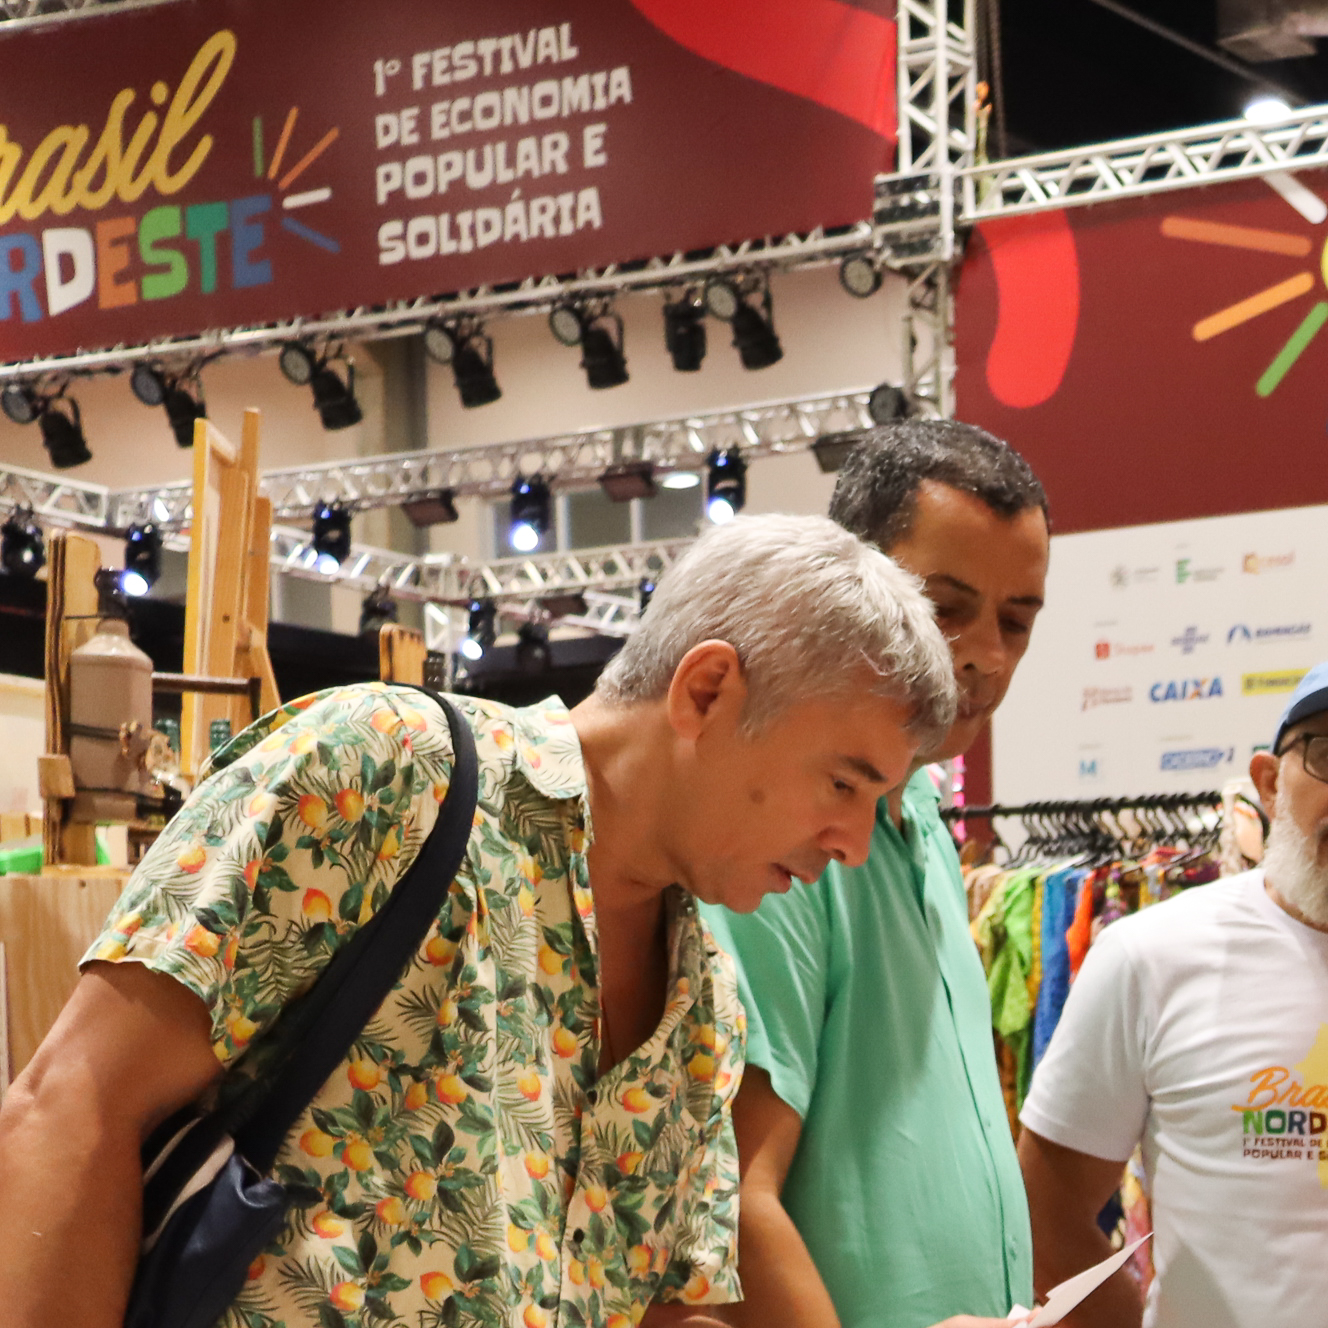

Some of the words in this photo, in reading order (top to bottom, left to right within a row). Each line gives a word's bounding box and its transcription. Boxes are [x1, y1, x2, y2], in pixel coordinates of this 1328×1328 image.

[412, 22, 579, 91] FESTIVAL
[375, 106, 421, 149] DE
[430, 65, 633, 140] ECONOMIA
[376, 131, 569, 205] POPULAR
[583, 122, 608, 169] E
[377, 187, 603, 266] SOLIDÁRIA
[1150, 676, 1223, 703] CAIXA
[1243, 1149, 1302, 1160] POPULAR
[1307, 1151, 1314, 1160] E
[1254, 1138, 1305, 1148] FESTIVAL
[1309, 1139, 1322, 1148] DE
